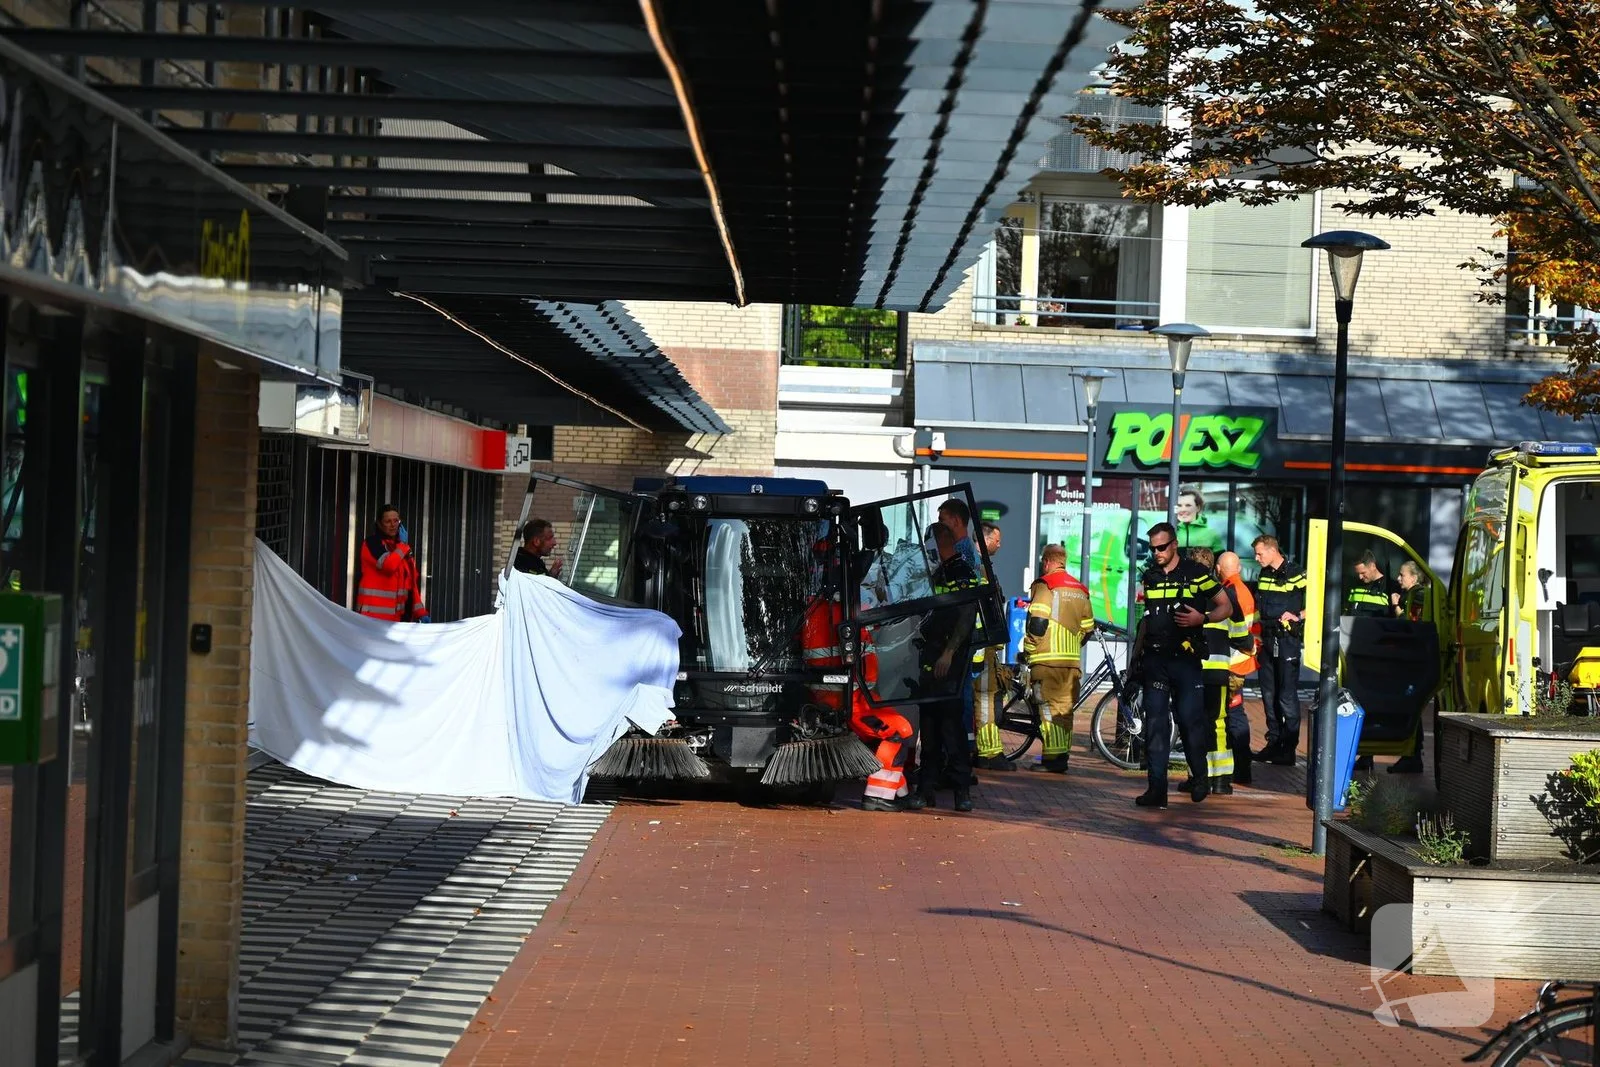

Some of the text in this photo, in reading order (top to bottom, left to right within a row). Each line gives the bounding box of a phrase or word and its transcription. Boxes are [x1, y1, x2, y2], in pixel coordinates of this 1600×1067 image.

[1106, 412, 1265, 469] POIESZ
[1055, 489, 1084, 498] “Onlin
[1055, 499, 1120, 510] boodsappen
[740, 683, 783, 693] schmidt
